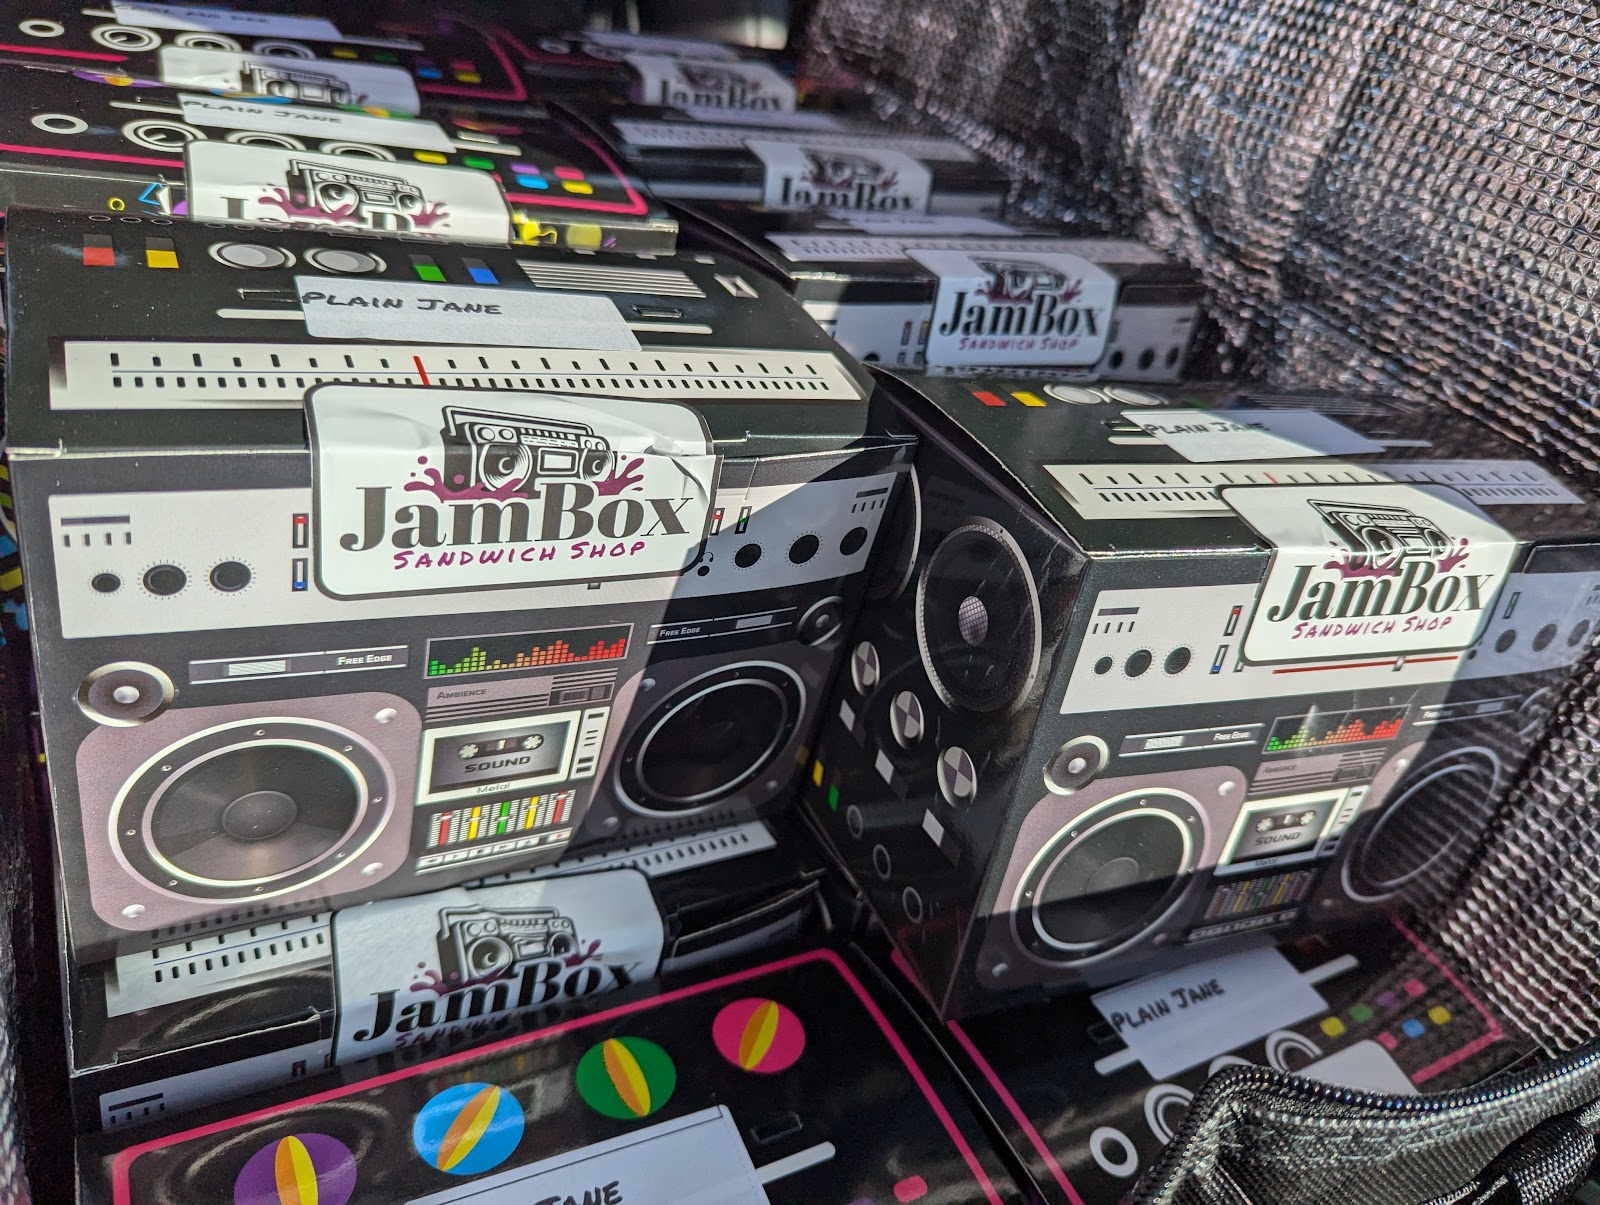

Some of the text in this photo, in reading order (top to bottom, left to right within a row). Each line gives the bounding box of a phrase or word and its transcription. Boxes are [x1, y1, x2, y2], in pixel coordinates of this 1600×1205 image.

[183, 100, 343, 124] PLAIN JANE
[301, 291, 503, 315] PLAIN JANE
[939, 291, 1104, 337] JamBox
[958, 336, 1078, 351] SANDWICH SHOP
[1142, 423, 1209, 435] PLAIN
[339, 482, 694, 551] JamBox
[393, 540, 646, 570] SANDWICH SHOP
[1266, 560, 1494, 623] JamBox
[1291, 615, 1453, 640] SANDWICH SHOP
[464, 755, 532, 773] SOUND
[477, 782, 510, 795] Metal
[1255, 831, 1301, 846] SOUND
[353, 957, 640, 1042] JamBox
[1110, 978, 1225, 1033] PLAIN JANE
